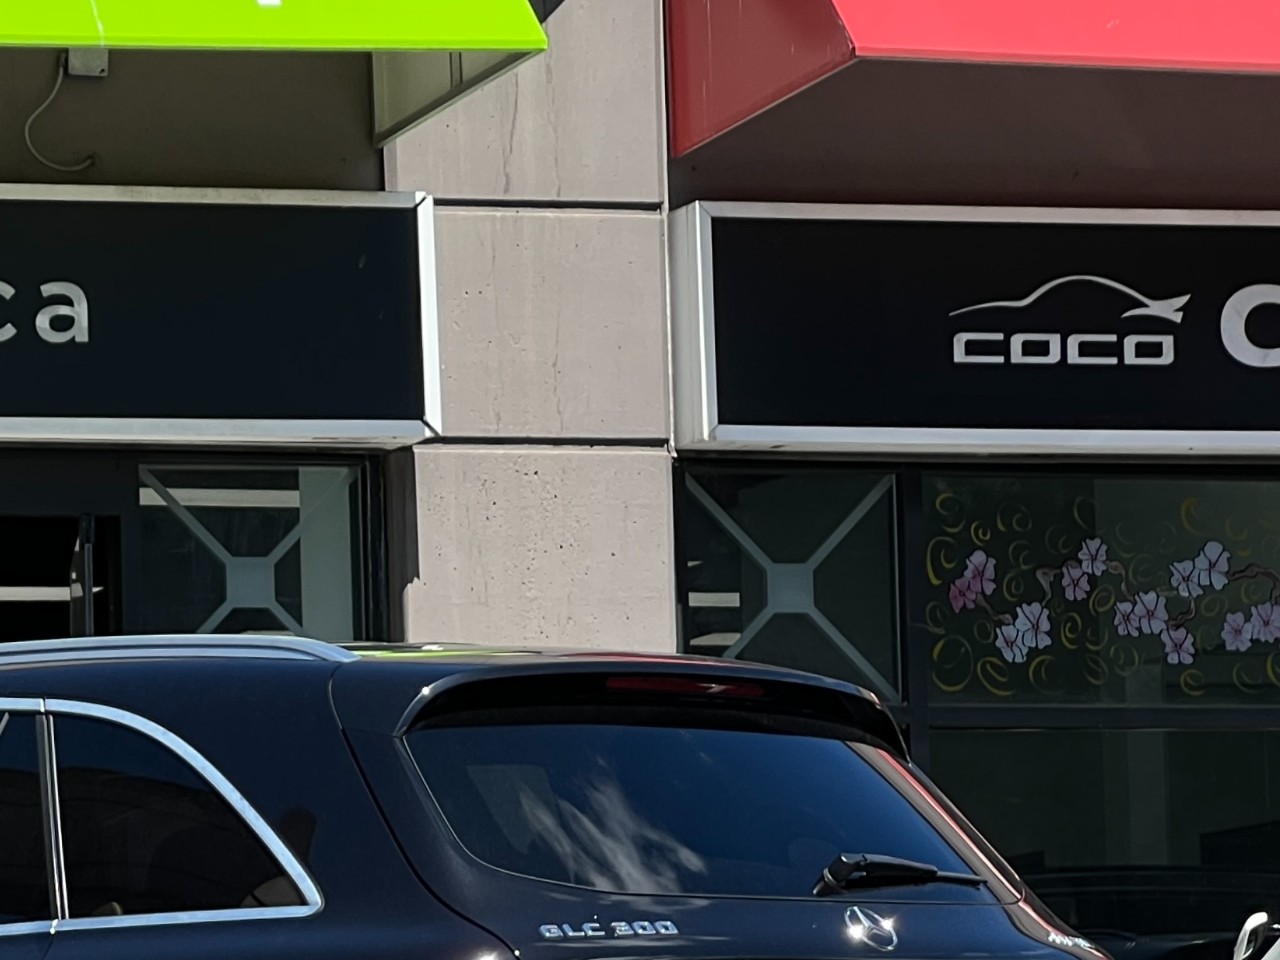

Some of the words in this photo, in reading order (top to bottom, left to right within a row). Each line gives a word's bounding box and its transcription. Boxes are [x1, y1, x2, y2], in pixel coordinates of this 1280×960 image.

[953, 332, 1175, 365] COCO
[539, 923, 606, 938] GLC
[610, 920, 679, 937] 300
